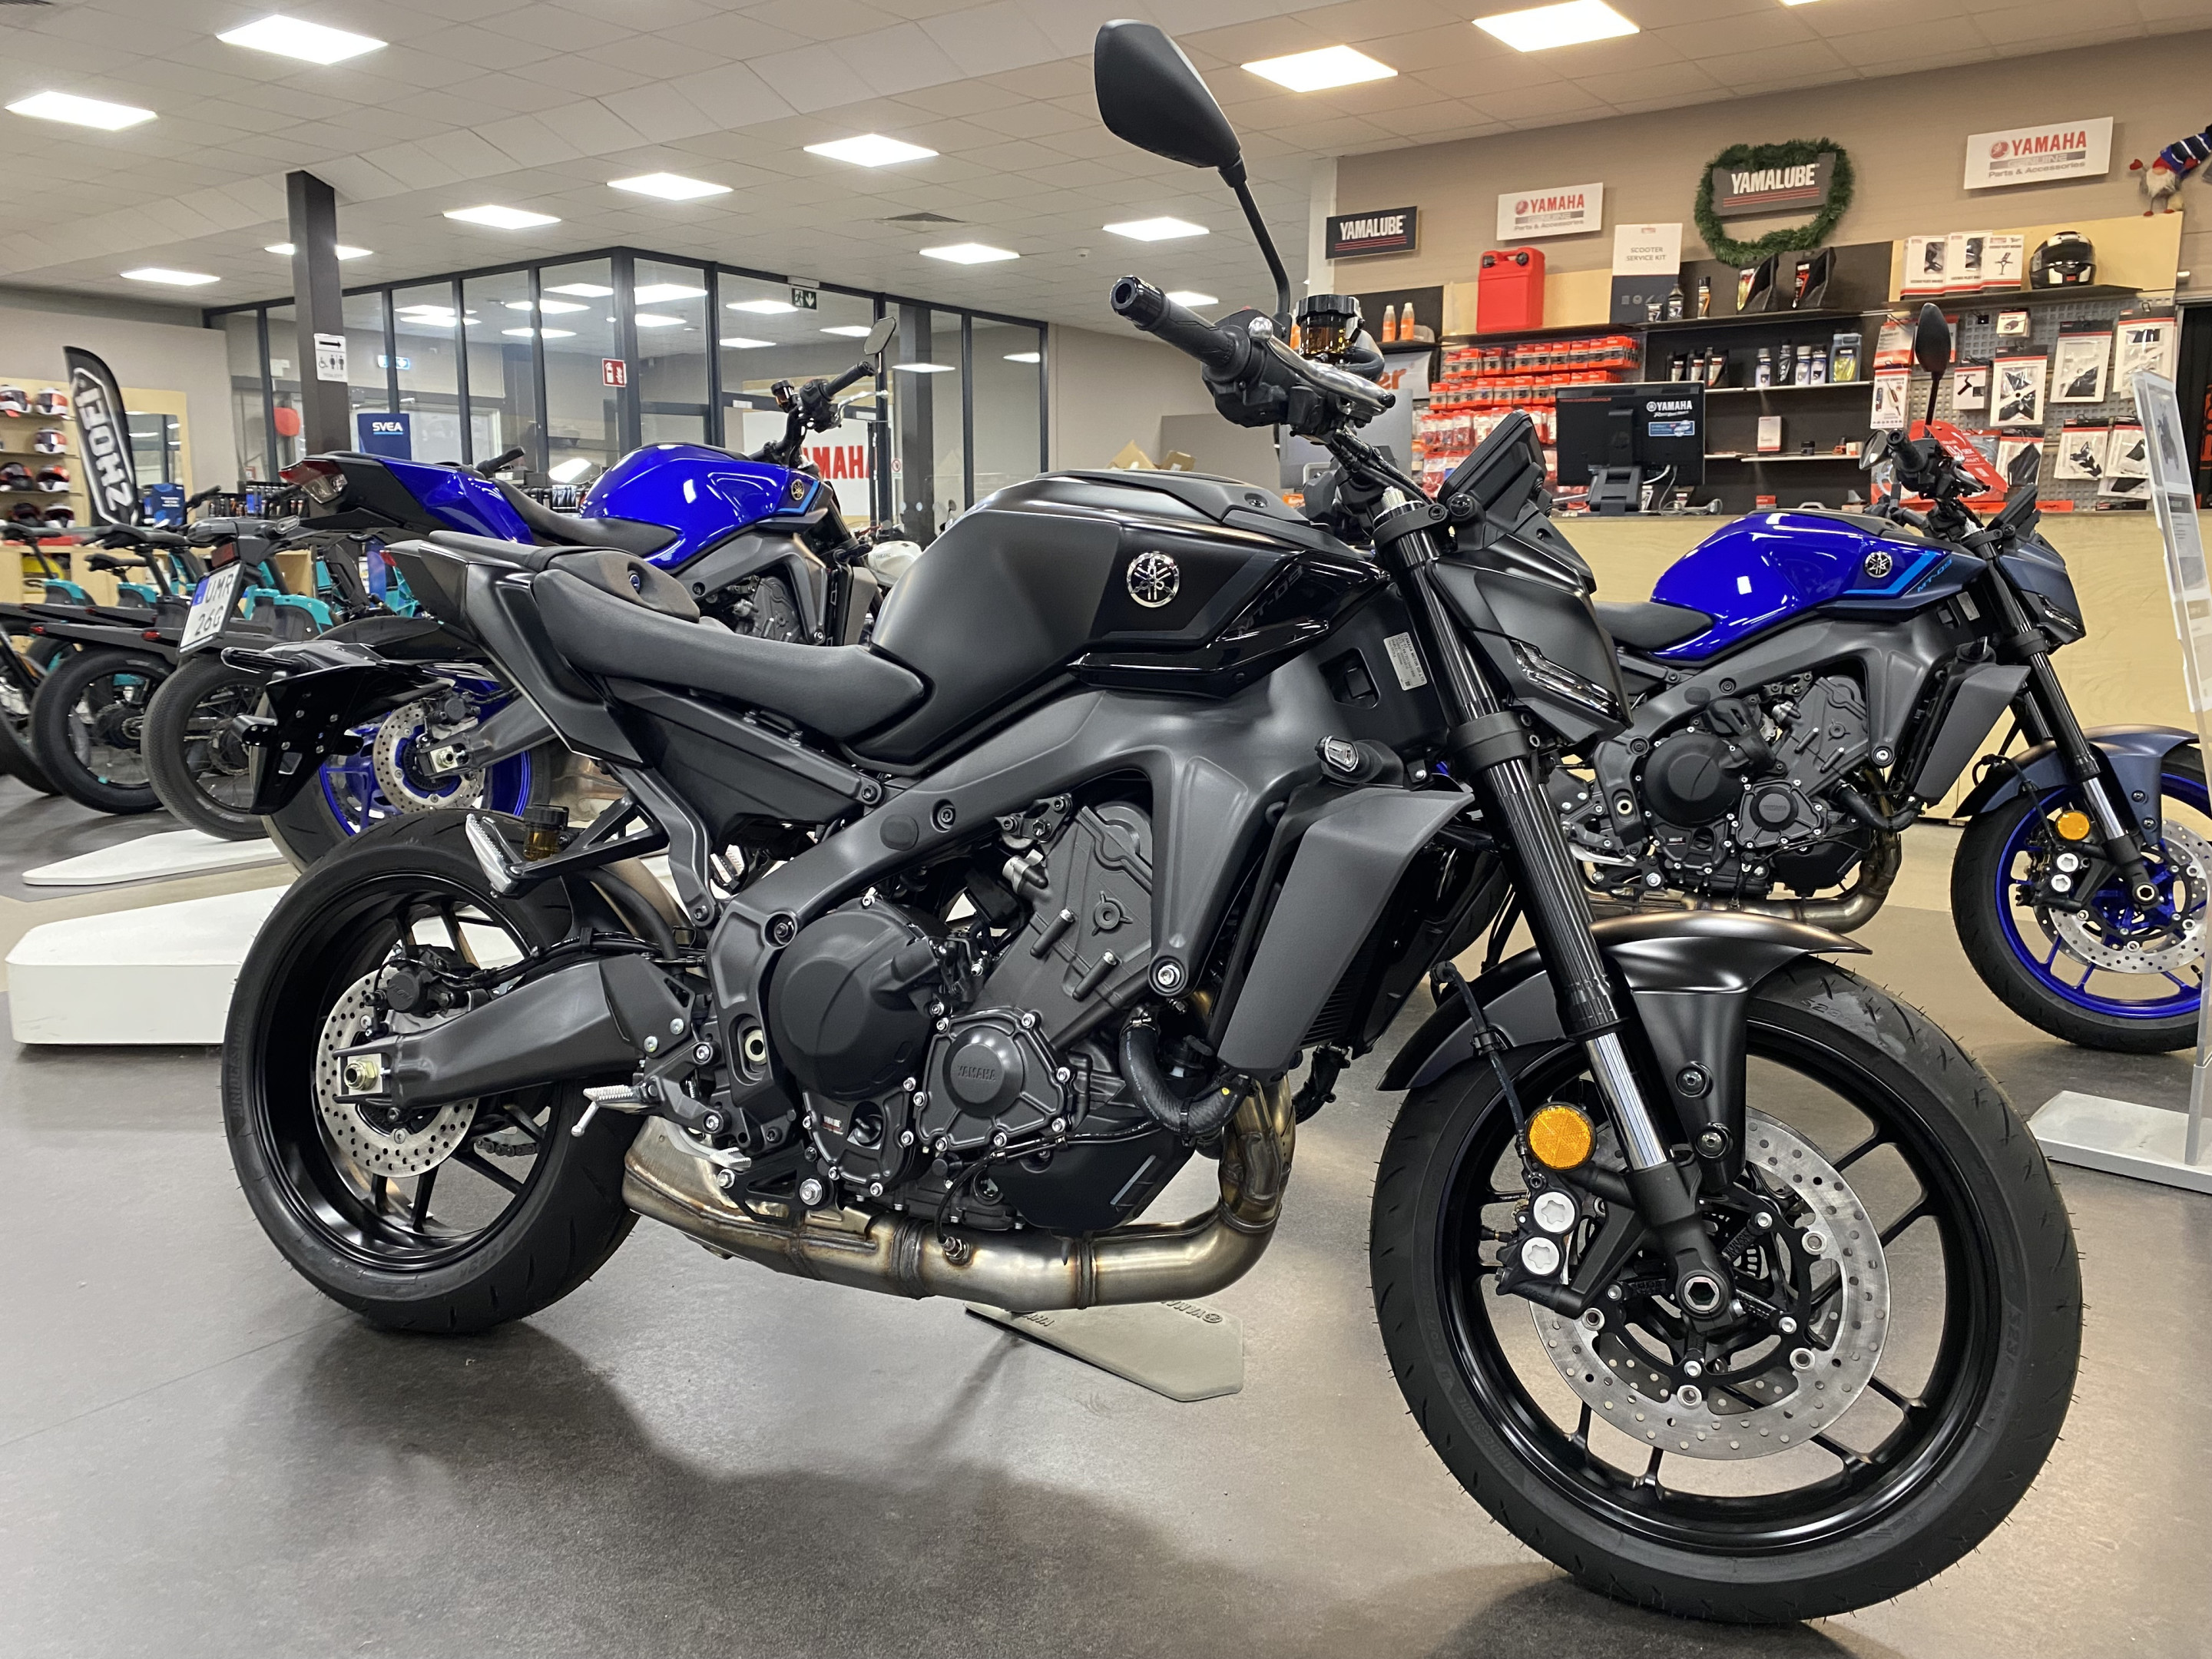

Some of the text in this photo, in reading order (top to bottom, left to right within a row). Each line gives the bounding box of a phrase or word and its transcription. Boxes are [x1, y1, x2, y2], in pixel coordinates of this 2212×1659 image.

[2012, 131, 2087, 156] YAMAHA
[1988, 170, 2013, 178] Parts
[2025, 162, 2085, 174] Accessories
[2008, 154, 2067, 167] GENUINE
[1731, 164, 1816, 194] YAMALUBE
[1531, 194, 1584, 214] YAMAHA
[1339, 215, 1404, 240] YAMALUBE
[1656, 400, 1693, 411] YAMAHA
[372, 422, 403, 432] SVEA
[205, 573, 233, 604] UMR
[194, 605, 224, 636] 26G
[959, 1065, 996, 1082] YAMAHA
